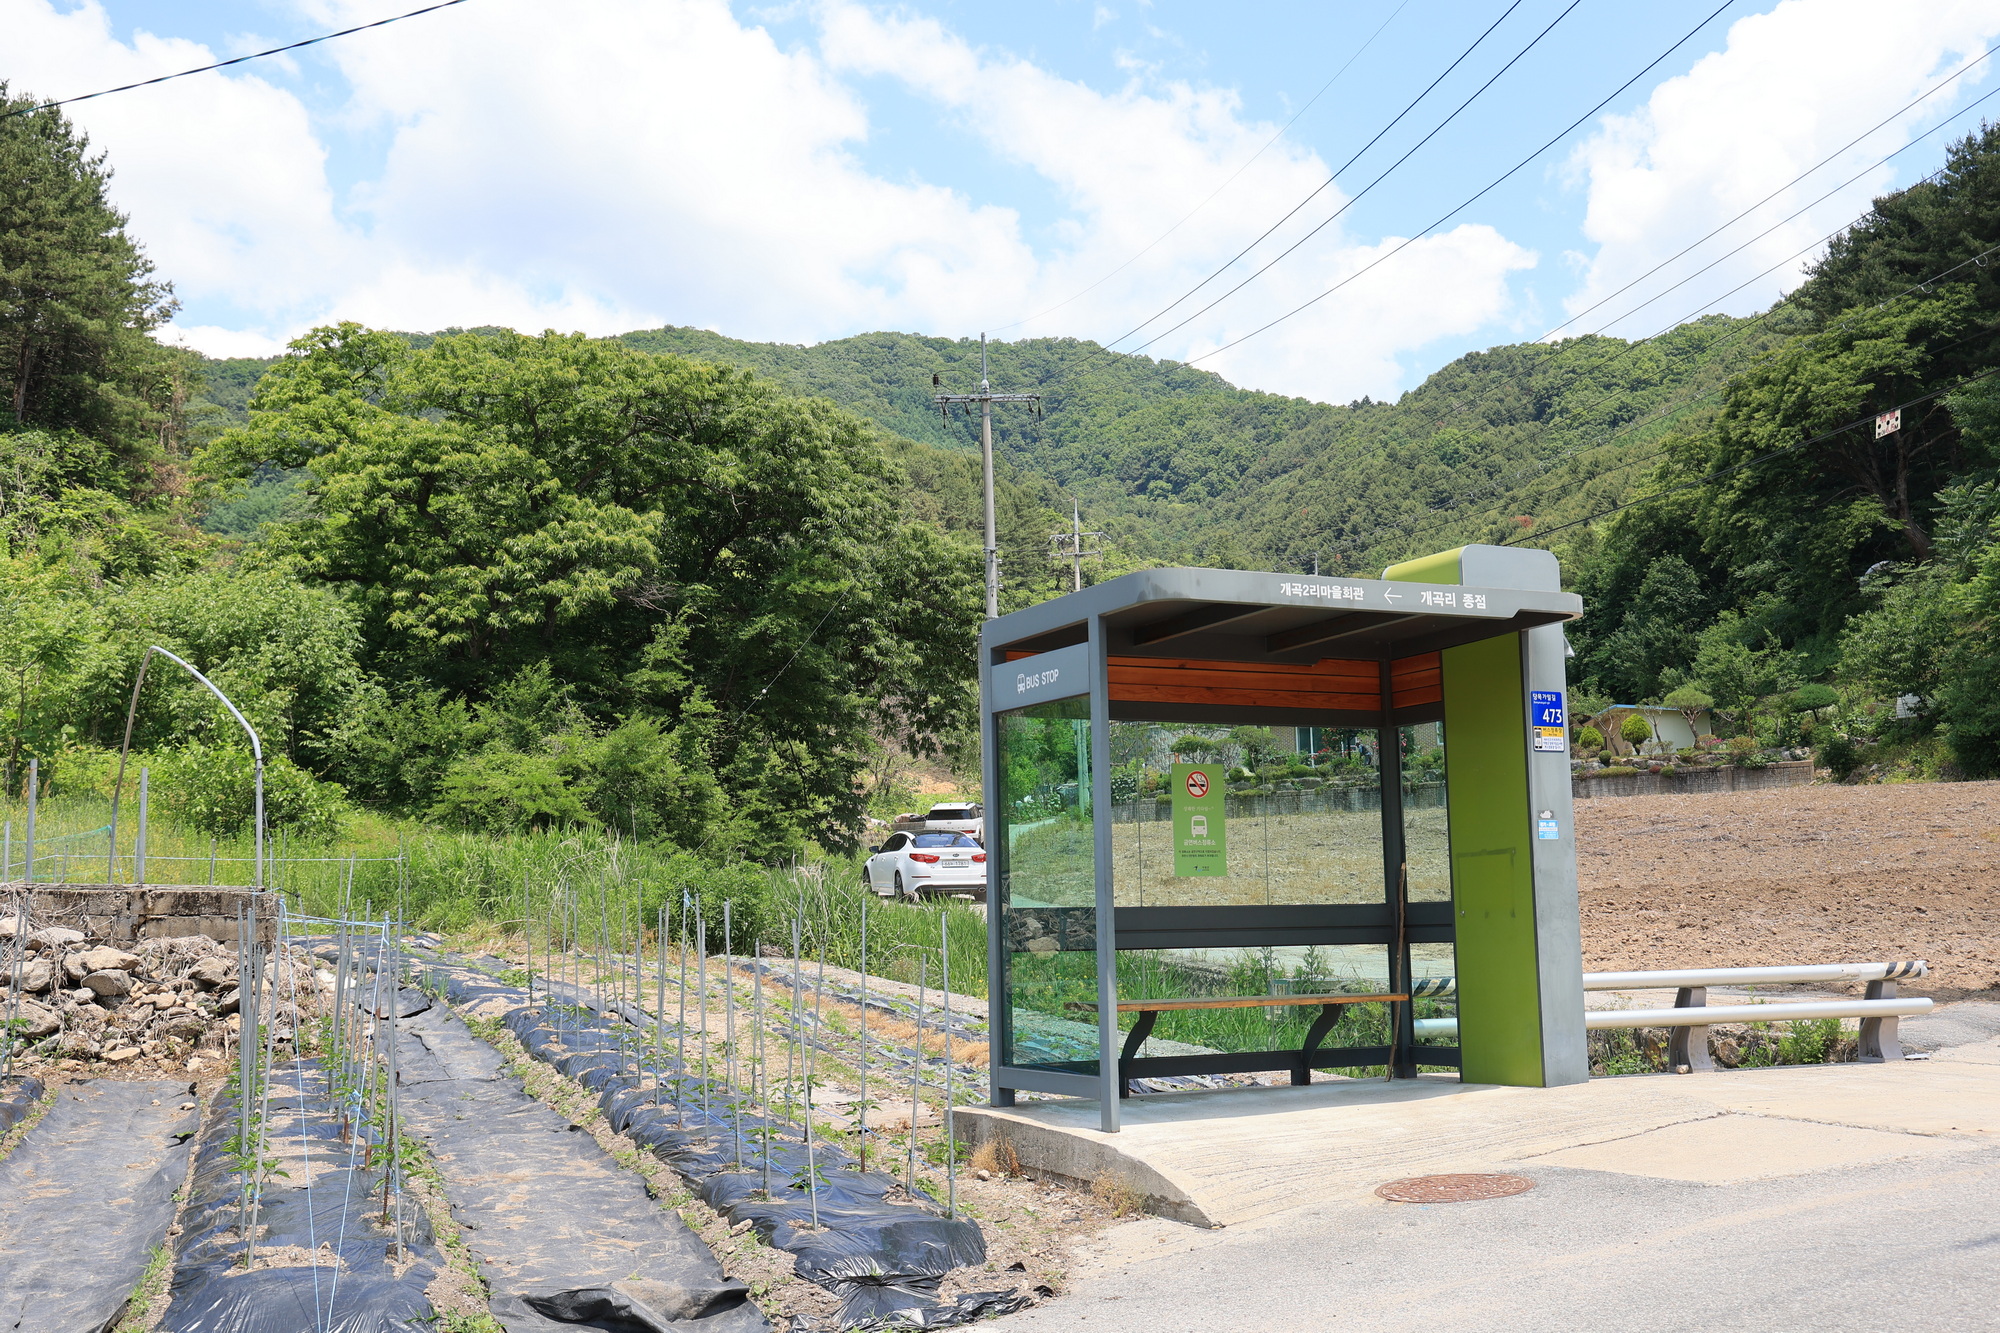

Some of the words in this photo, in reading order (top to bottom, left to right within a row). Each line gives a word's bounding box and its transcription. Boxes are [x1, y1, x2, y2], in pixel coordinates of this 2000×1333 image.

[1280, 582, 1364, 601] 개곡2리마을회관
[1420, 590, 1456, 607] 개곡리
[1462, 593, 1486, 610] 종점
[1026, 673, 1040, 690] BUS
[1041, 668, 1059, 685] STOP
[1542, 708, 1562, 723] 473
